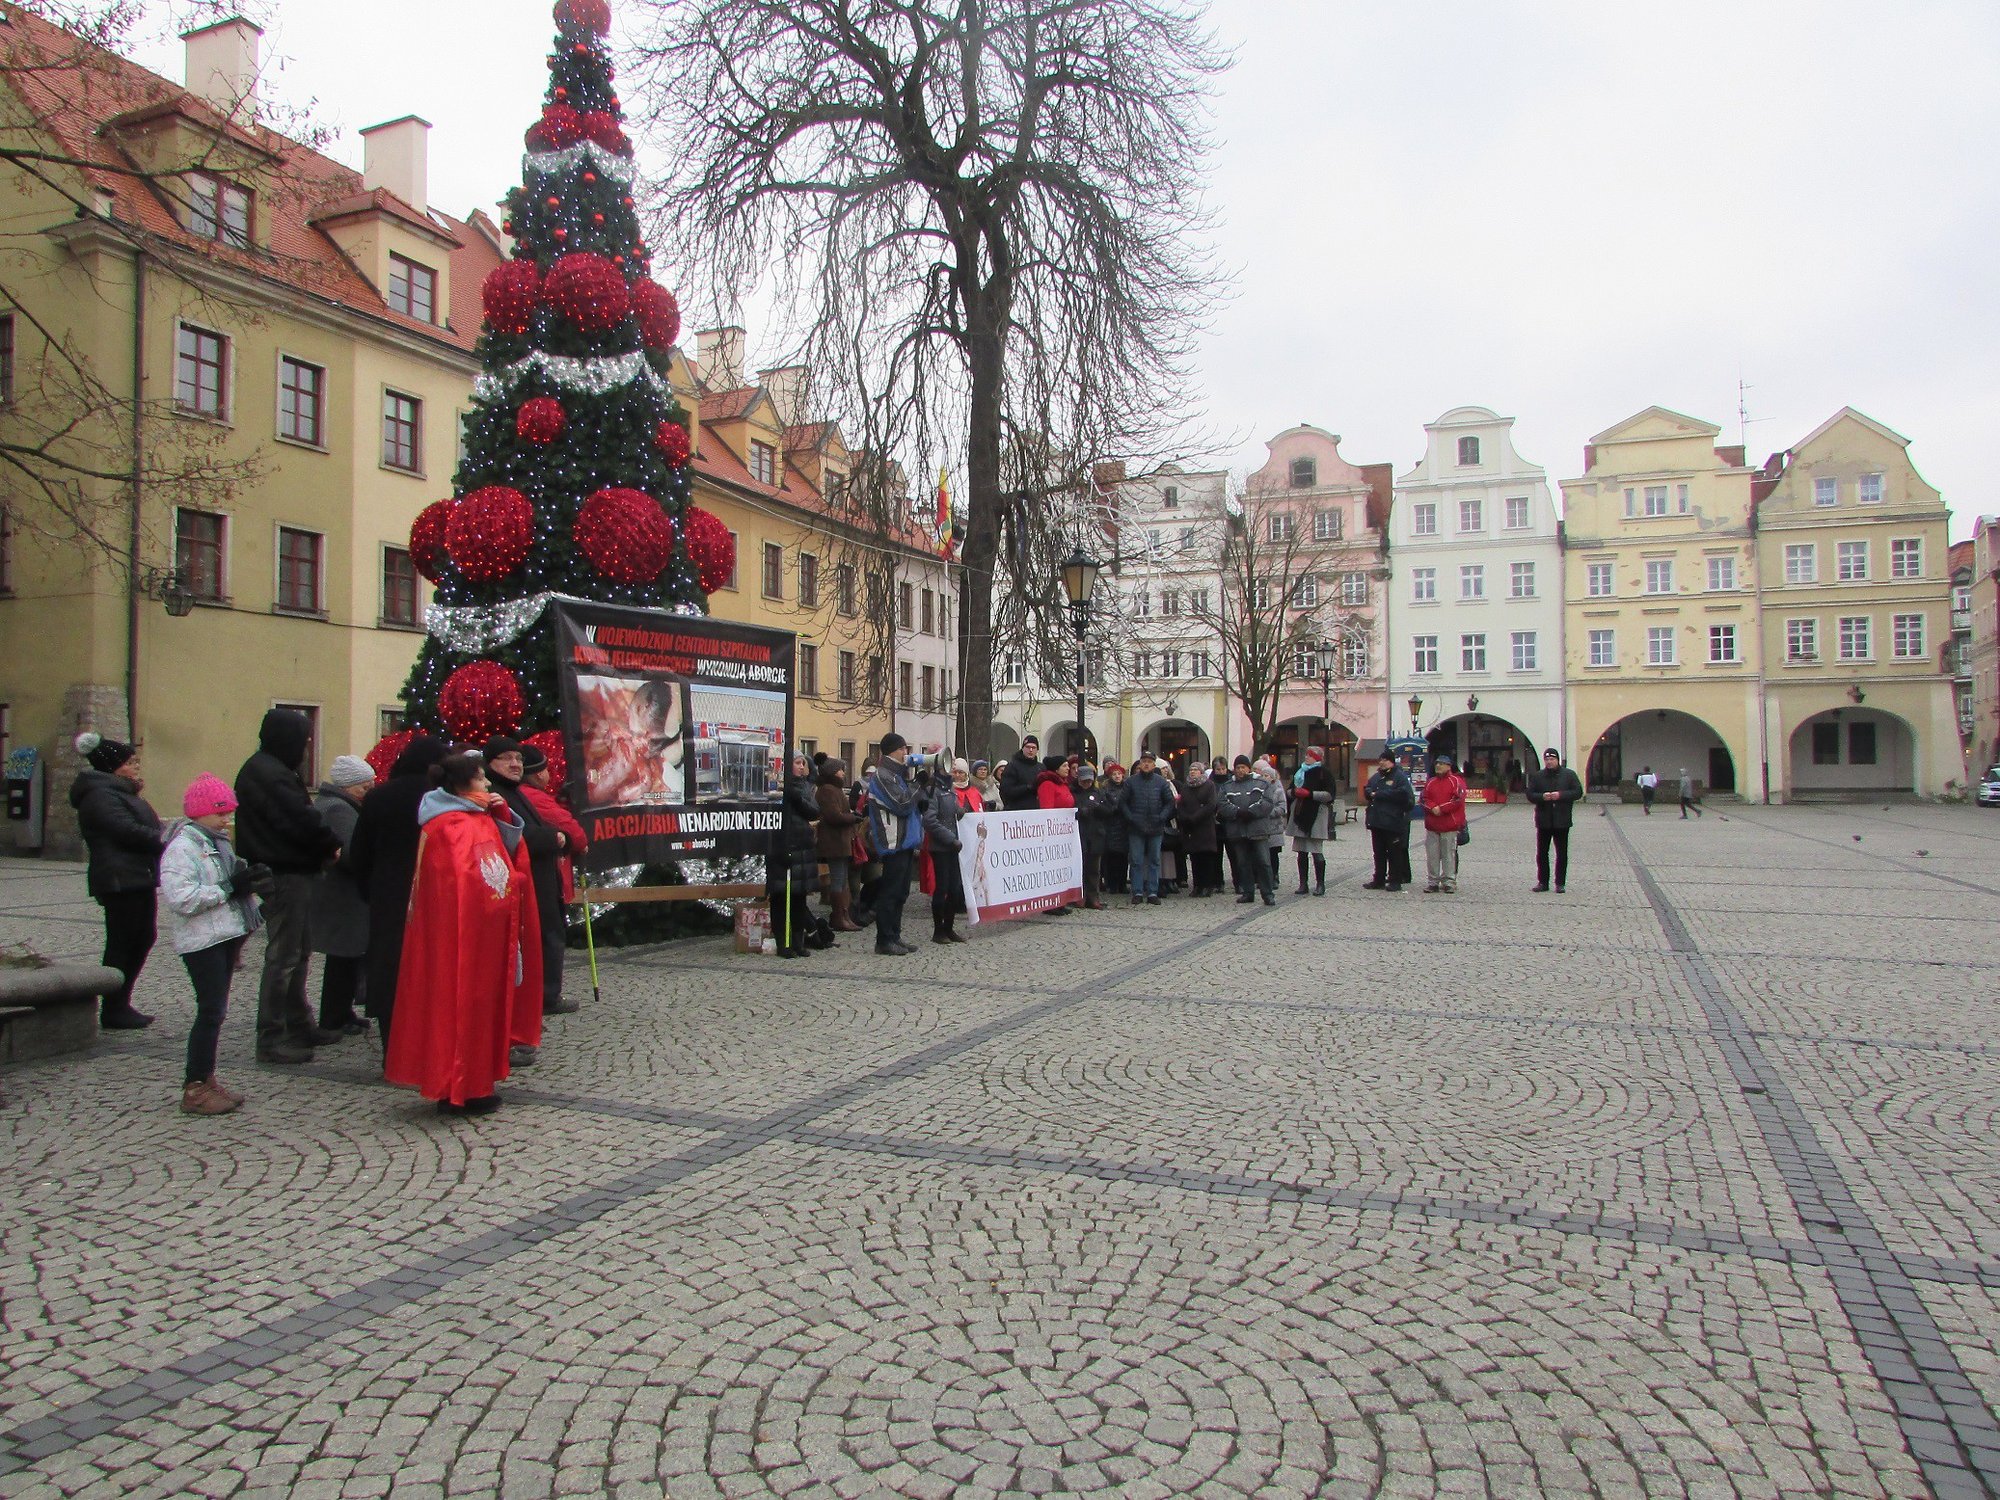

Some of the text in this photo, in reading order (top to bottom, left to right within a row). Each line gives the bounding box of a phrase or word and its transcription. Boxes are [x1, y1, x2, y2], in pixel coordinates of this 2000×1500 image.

[586, 624, 771, 662] W WOJEWÓDZKIM CENTRUM SZPITALNYM
[696, 659, 747, 684] WYKONUJĄ
[748, 664, 787, 685] ABORCJE
[1002, 820, 1045, 842] Publiczny
[990, 851, 999, 869] O
[1002, 846, 1044, 868] ODNOWĘ
[1003, 872, 1041, 895] NARODU
